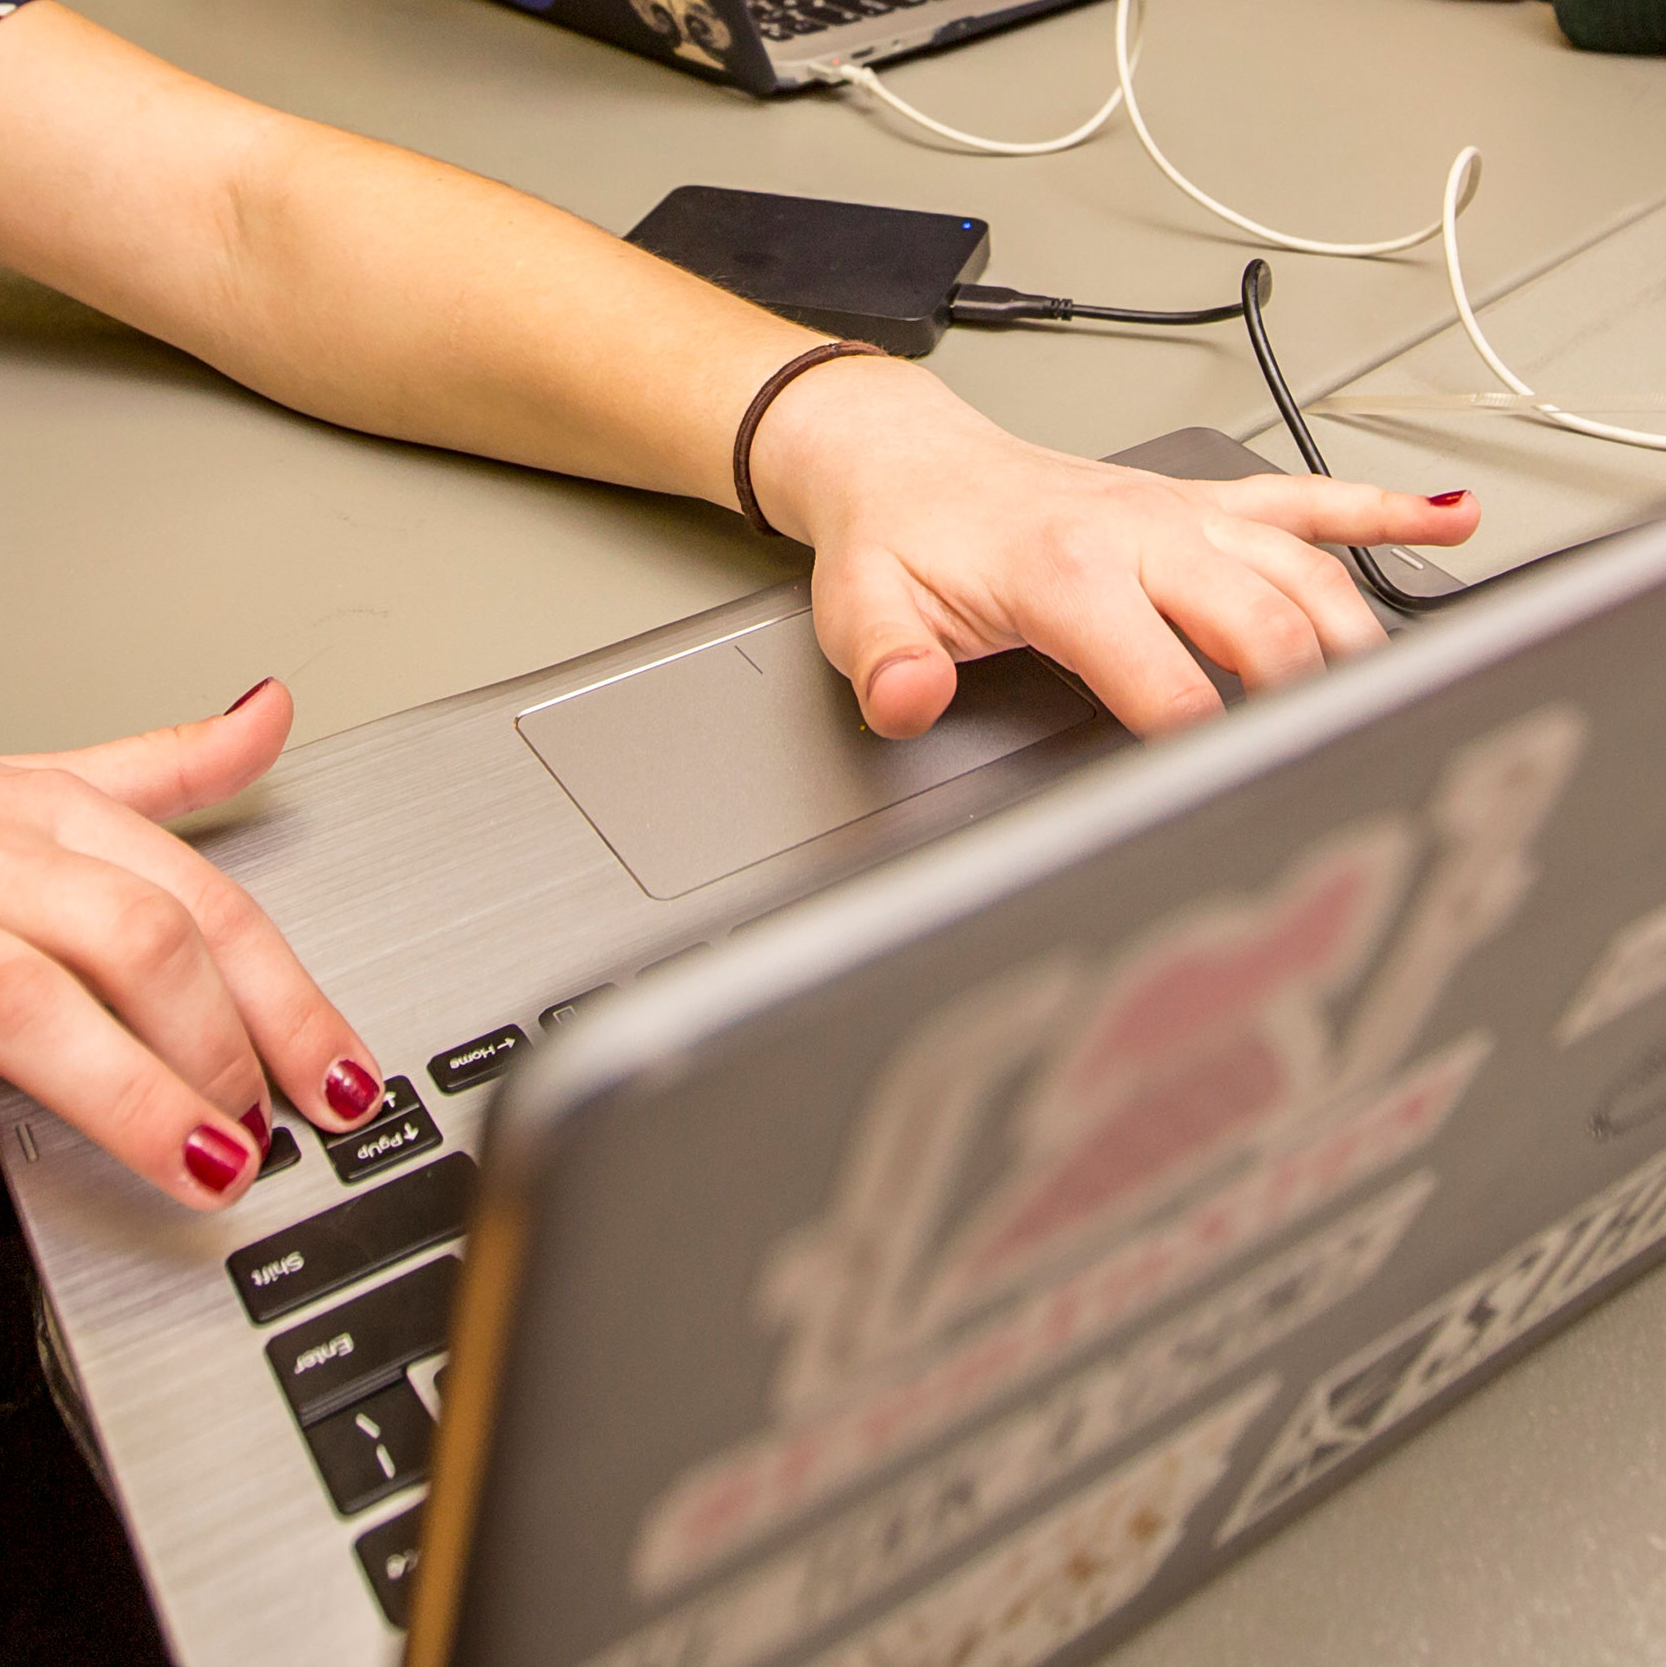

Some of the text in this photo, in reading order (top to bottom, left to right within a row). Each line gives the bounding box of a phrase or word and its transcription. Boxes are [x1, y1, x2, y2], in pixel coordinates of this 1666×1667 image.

[449, 1044, 496, 1070] Home
[357, 1132, 404, 1160] PgUp
[251, 1250, 305, 1286] Shift
[294, 1332, 355, 1375] Enter
